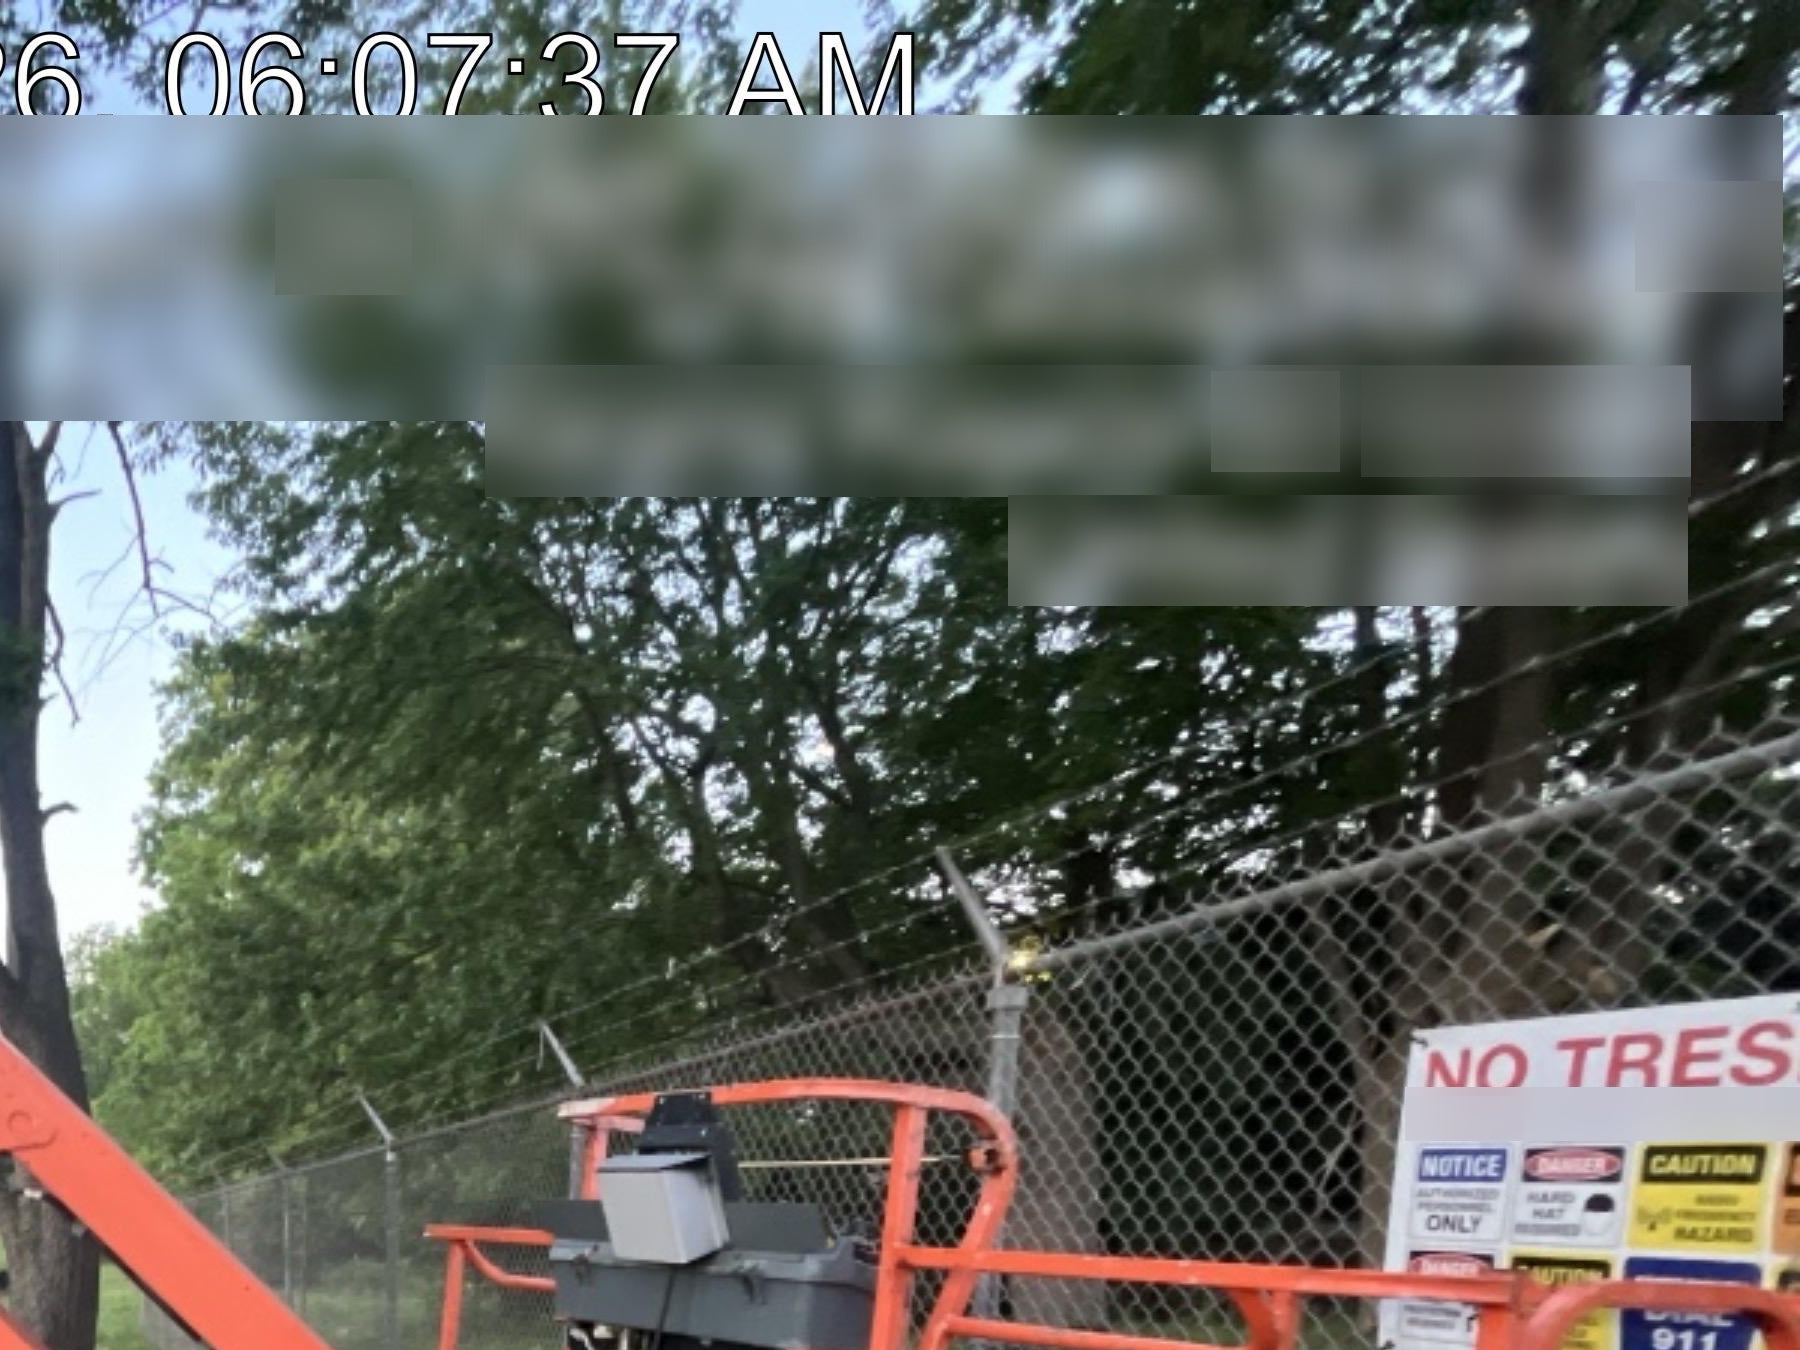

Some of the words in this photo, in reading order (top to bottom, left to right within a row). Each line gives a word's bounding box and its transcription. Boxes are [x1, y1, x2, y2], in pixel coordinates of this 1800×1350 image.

[1425, 1044, 1528, 1087] NO
[1421, 1153, 1501, 1177] NOTICE
[1538, 1155, 1606, 1175] DANGER
[1650, 1154, 1756, 1175] CAUTION
[1526, 1191, 1576, 1204] HARD
[1533, 1208, 1566, 1219] HAT
[1426, 1214, 1482, 1233] ONLY
[1674, 1227, 1753, 1242] HAZARD
